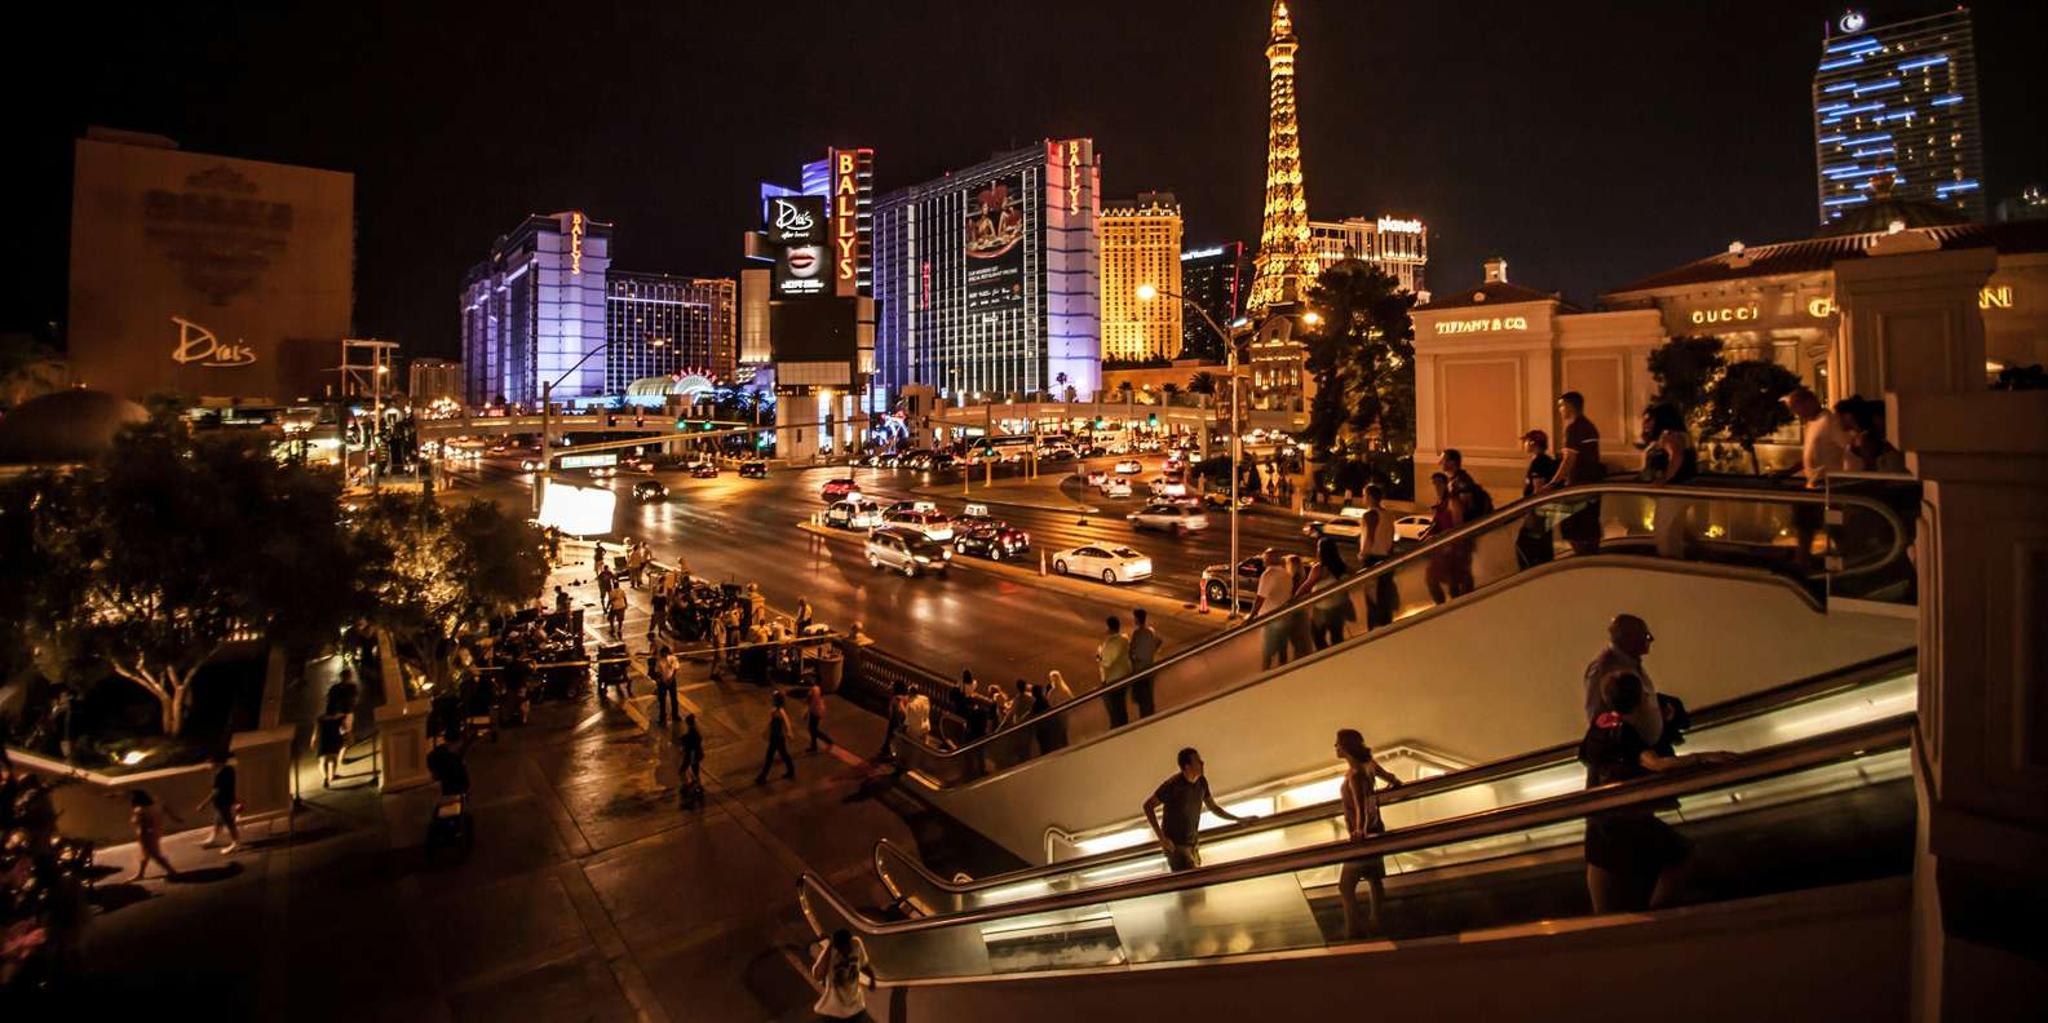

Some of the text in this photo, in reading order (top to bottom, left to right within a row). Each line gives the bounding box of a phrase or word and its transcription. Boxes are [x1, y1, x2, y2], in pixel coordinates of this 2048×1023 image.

[838, 154, 855, 280] BALLYS
[1692, 306, 1758, 323] GUCCI
[1809, 298, 1839, 318] G
[1435, 319, 1490, 335] TIFFANY
[1491, 318, 1502, 331] &
